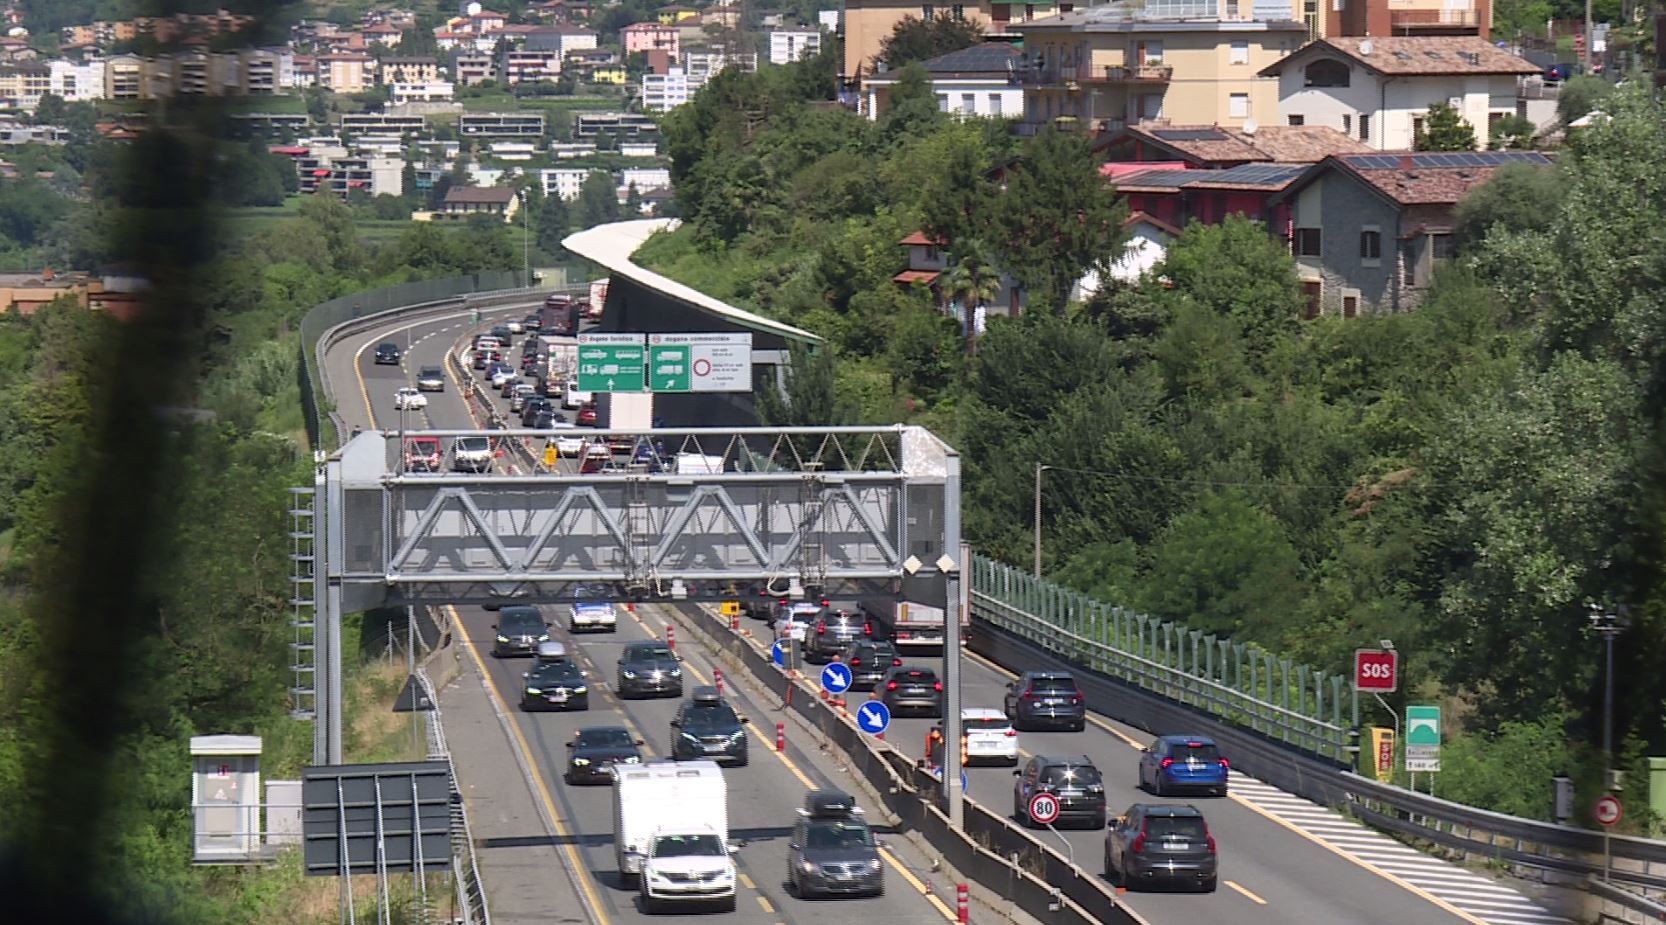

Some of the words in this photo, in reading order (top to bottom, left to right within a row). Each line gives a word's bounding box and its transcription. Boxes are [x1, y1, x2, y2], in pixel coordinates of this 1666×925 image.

[1362, 663, 1391, 678] SOS
[1381, 743, 1390, 769] SOS
[1036, 801, 1053, 815] 80
